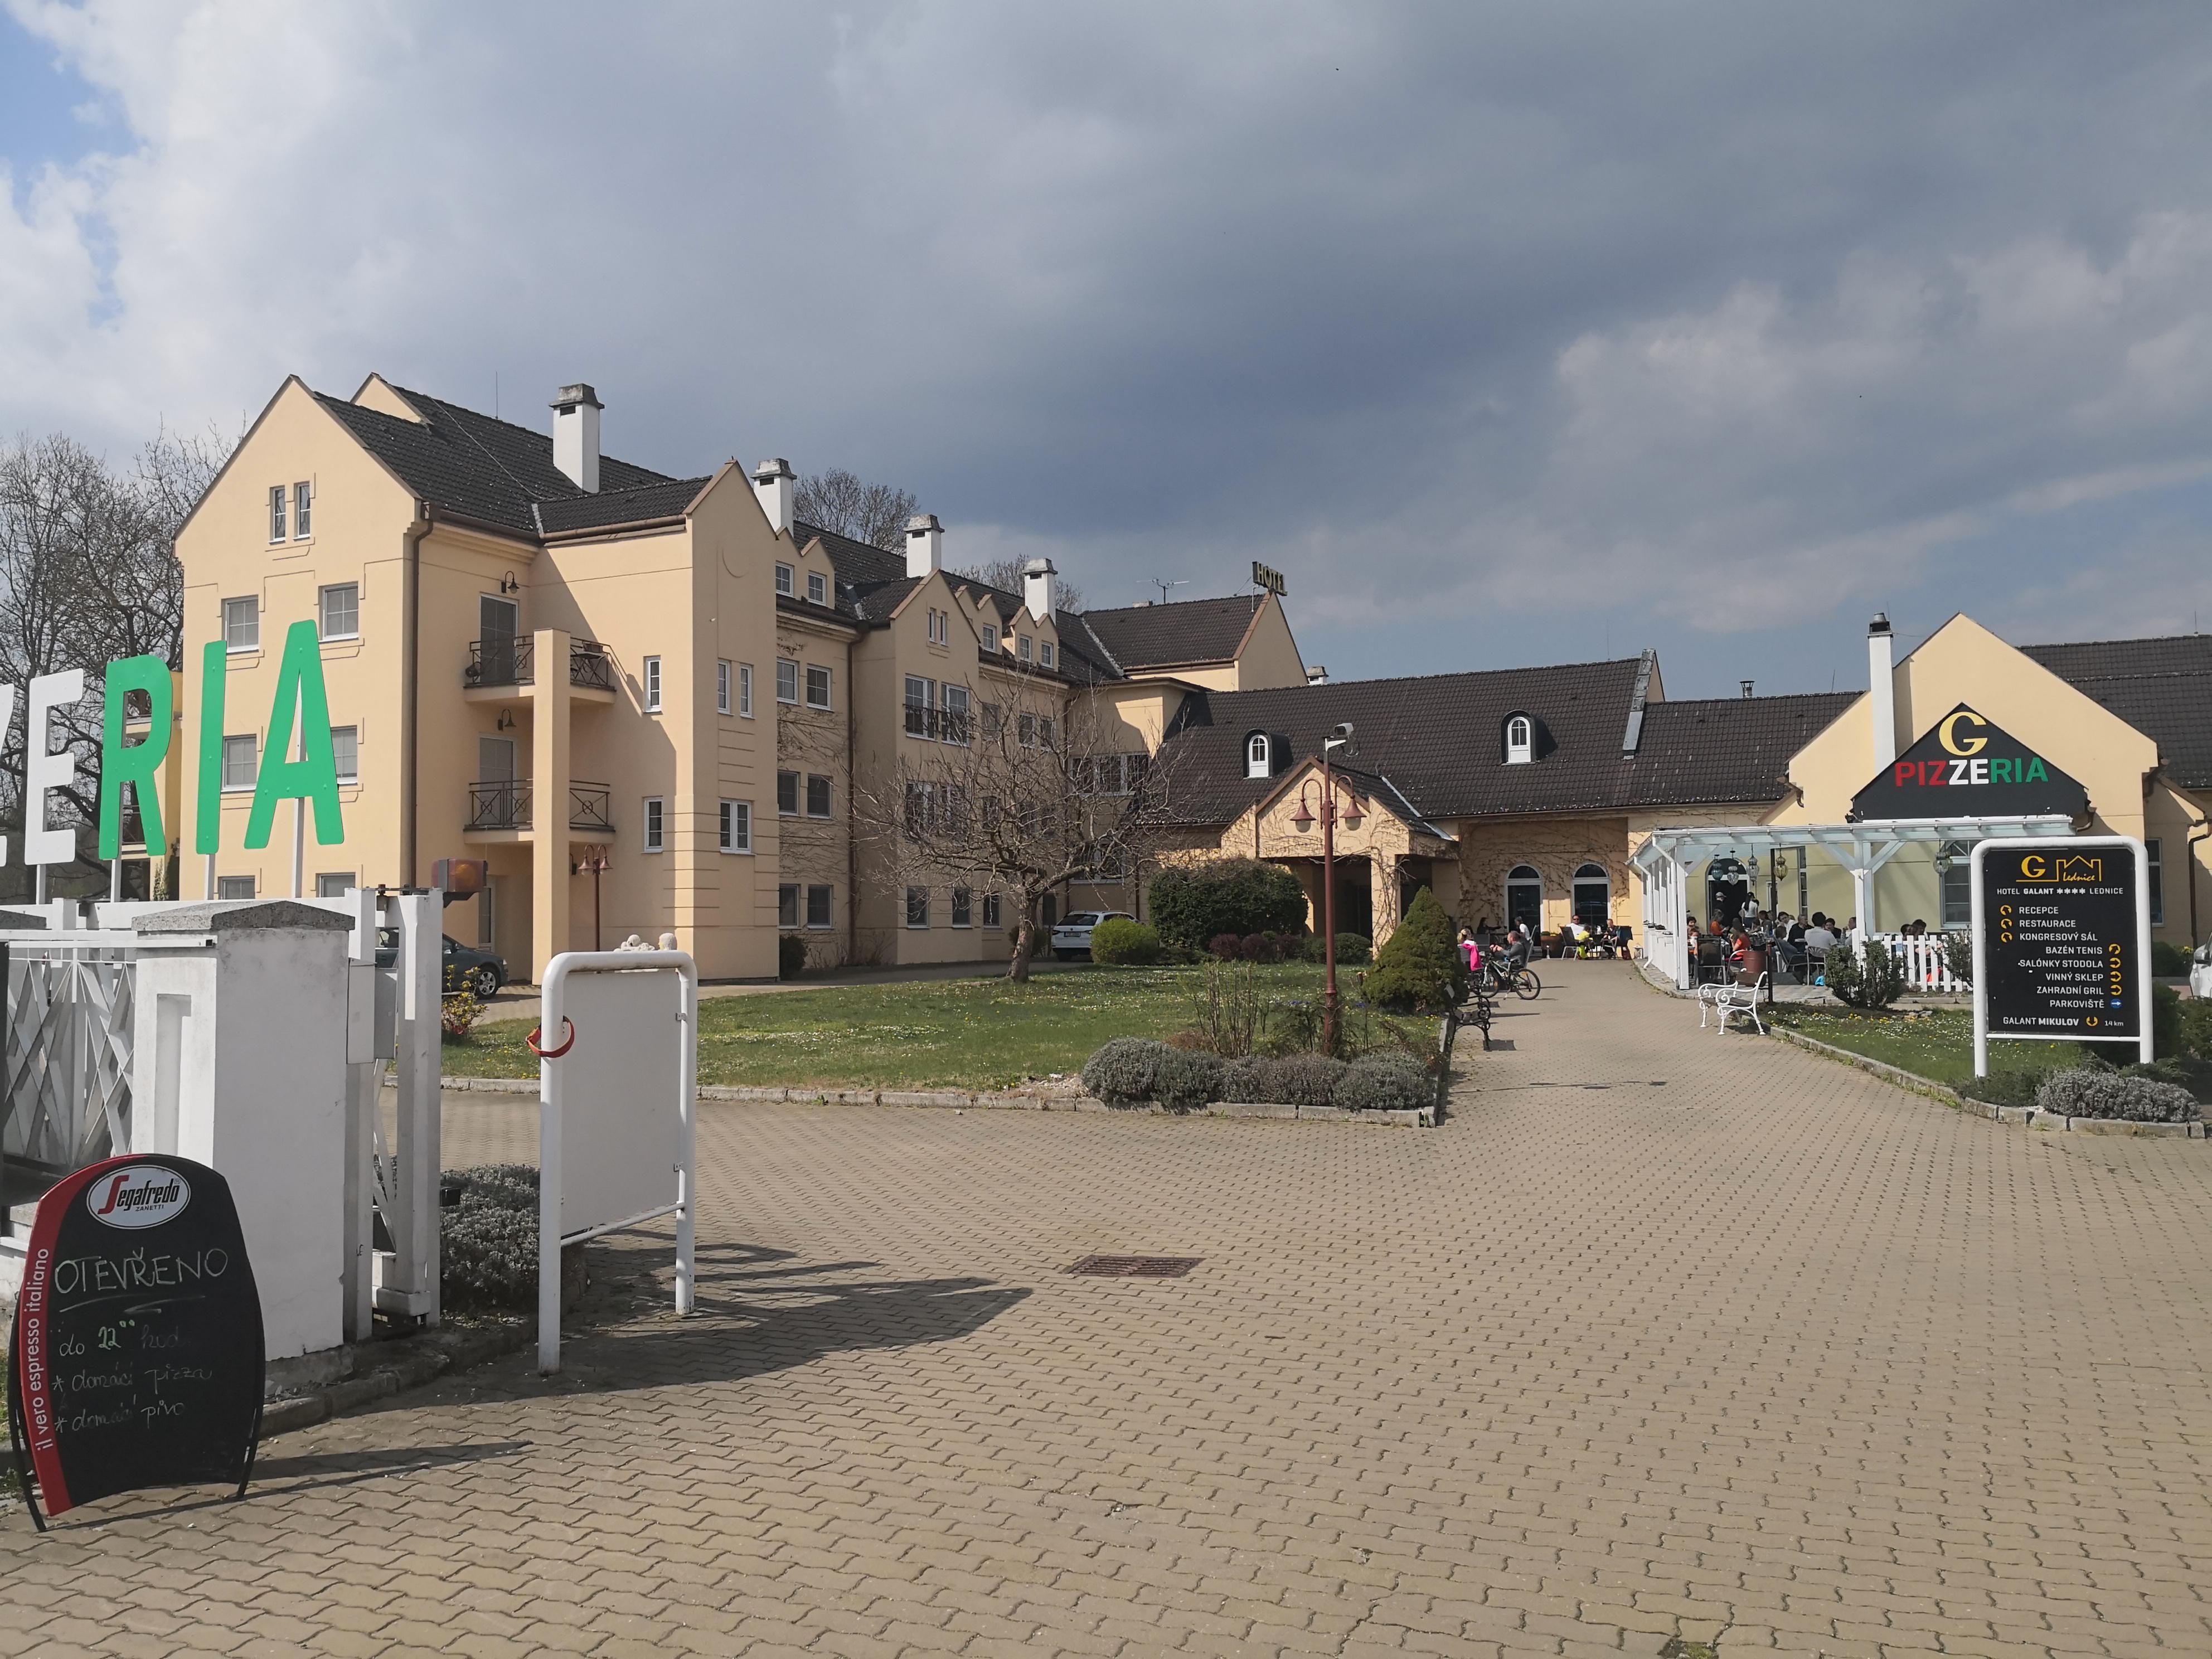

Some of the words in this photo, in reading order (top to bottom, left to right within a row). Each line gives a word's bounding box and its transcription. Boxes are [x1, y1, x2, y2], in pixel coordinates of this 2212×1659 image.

[1257, 562, 1286, 593] HOTEL
[1939, 711, 1988, 756] G
[1895, 758, 2049, 787] PIZZERIA
[2021, 855, 2046, 877] G
[2020, 932, 2079, 941] KONGRESOVÝ
[2081, 932, 2098, 941] SÁL
[2046, 945, 2075, 954] BAZÉN
[2020, 958, 2060, 967] SALÓNKY
[2046, 972, 2073, 981] VINNÝ
[2036, 985, 2082, 994] ZAHRADNÍ
[2050, 999, 2104, 1008] PARKOVIŠTĚ
[98, 1175, 180, 1215] Segafredo
[24, 1249, 49, 1312] italiano
[28, 1318, 45, 1391] espresso
[59, 1333, 85, 1357] do
[33, 1396, 49, 1435] vero
[140, 1400, 185, 1429] pivo
[35, 1438, 54, 1451] il
